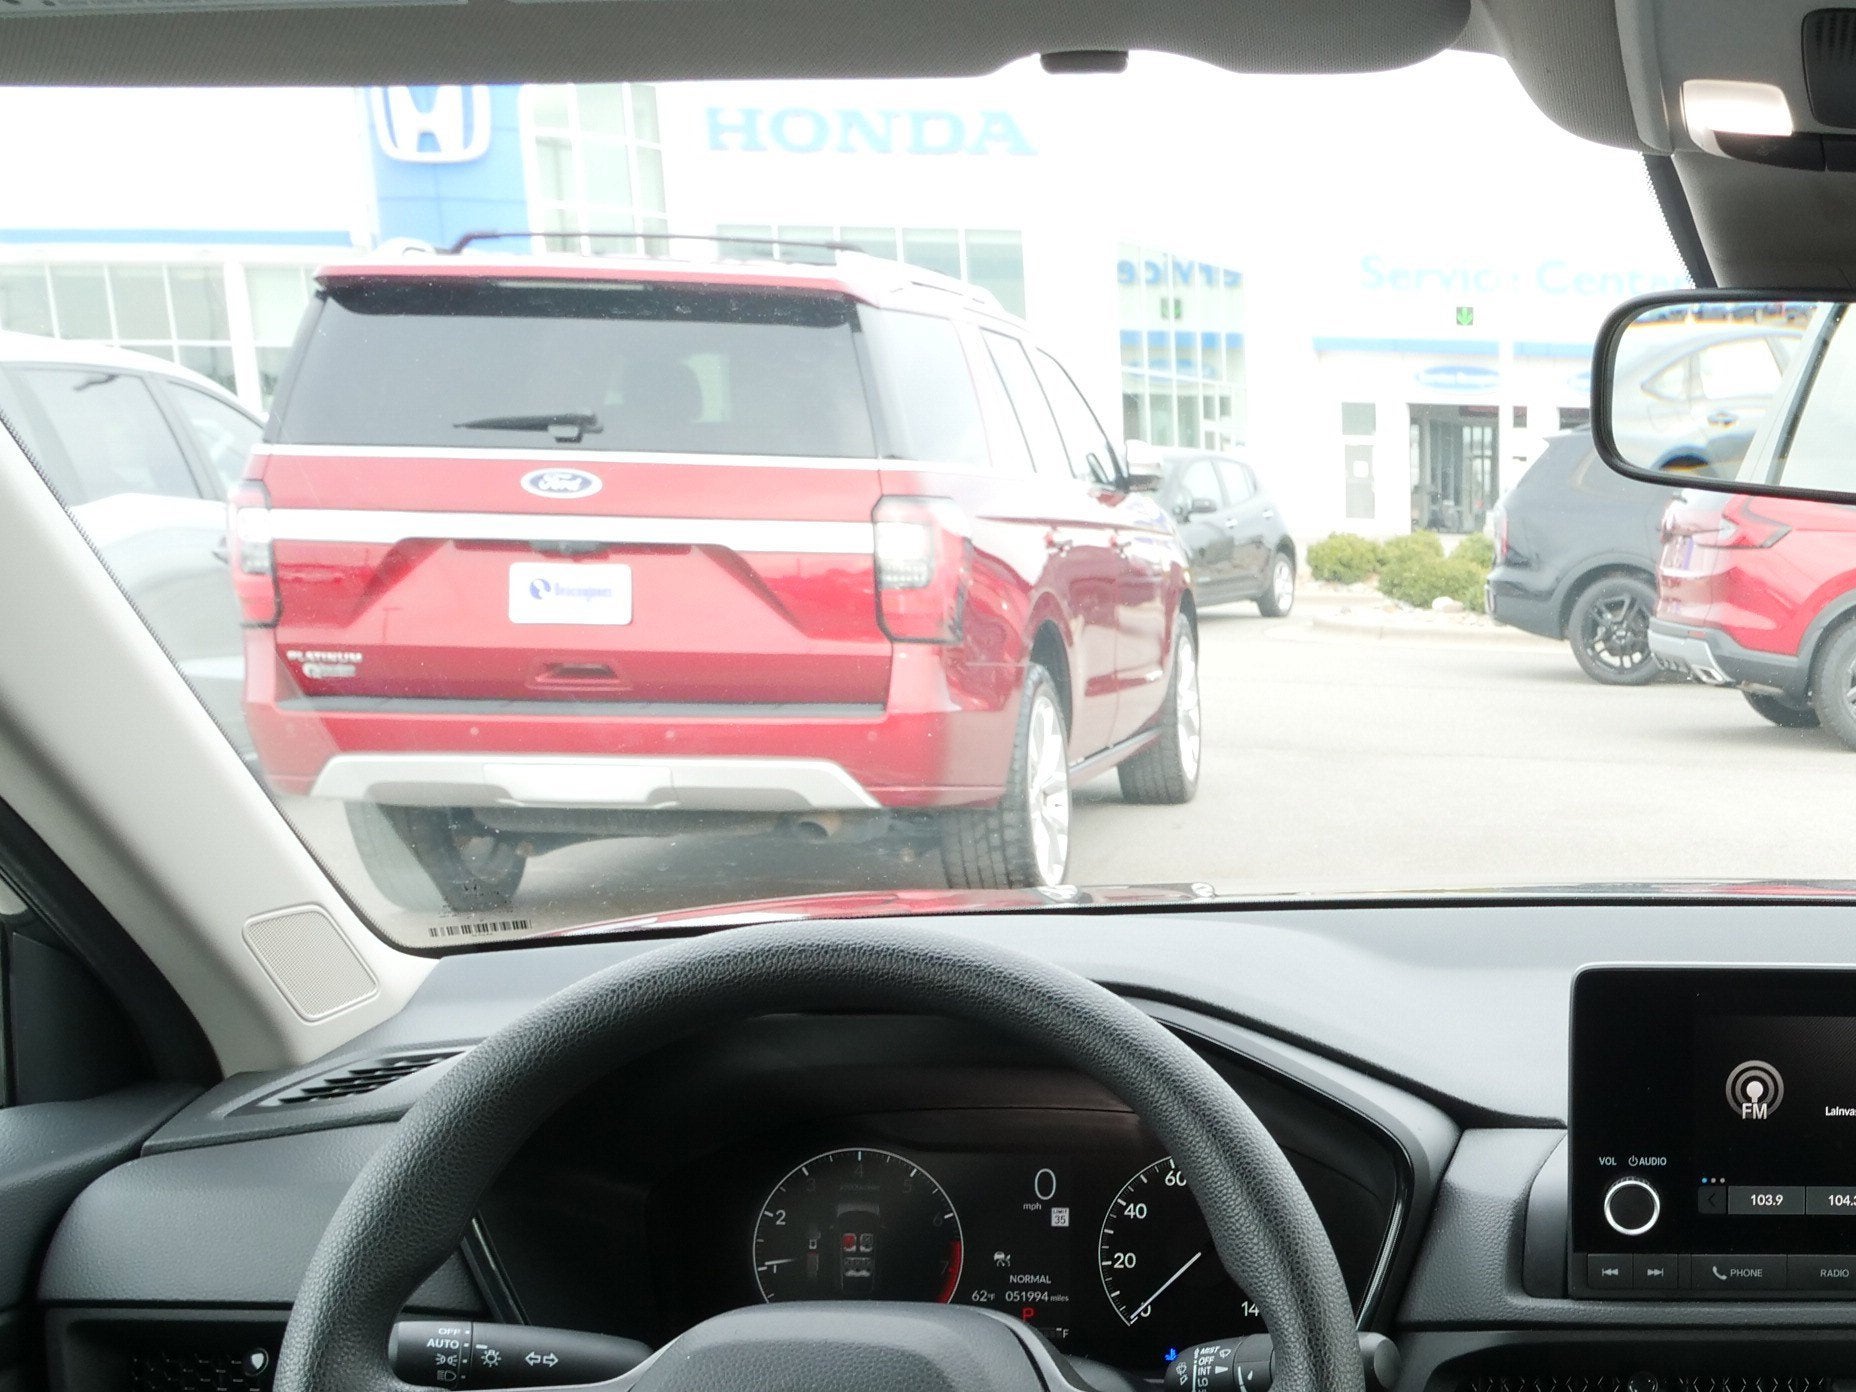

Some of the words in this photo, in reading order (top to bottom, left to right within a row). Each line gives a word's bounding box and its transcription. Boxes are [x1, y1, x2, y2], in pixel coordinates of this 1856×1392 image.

[704, 106, 1038, 156] HONDA
[1741, 1102, 1768, 1120] FM
[1598, 1156, 1617, 1167] VOL
[1638, 1156, 1668, 1167] AUDIO
[1034, 1168, 1057, 1200] 0
[1164, 1170, 1187, 1187] 60
[1750, 1194, 1784, 1206] 103.9
[1022, 1202, 1042, 1211] mph
[1123, 1202, 1148, 1219] 40
[775, 1209, 786, 1226] 2
[1054, 1214, 1067, 1225] 35
[1113, 1252, 1137, 1269] 20
[1730, 1268, 1763, 1278] PHONE
[1820, 1268, 1850, 1278] RADIO
[1009, 1274, 1052, 1285] NORMAL
[1005, 1290, 1049, 1302] 051994
[1050, 1294, 1070, 1302] miles
[1022, 1307, 1035, 1323] P
[1240, 1301, 1260, 1317] 14
[438, 1327, 462, 1336] OFF
[426, 1338, 460, 1350] AUTO
[1198, 1355, 1215, 1366] OFF
[1197, 1365, 1212, 1376] INT
[1197, 1377, 1209, 1388] LO
